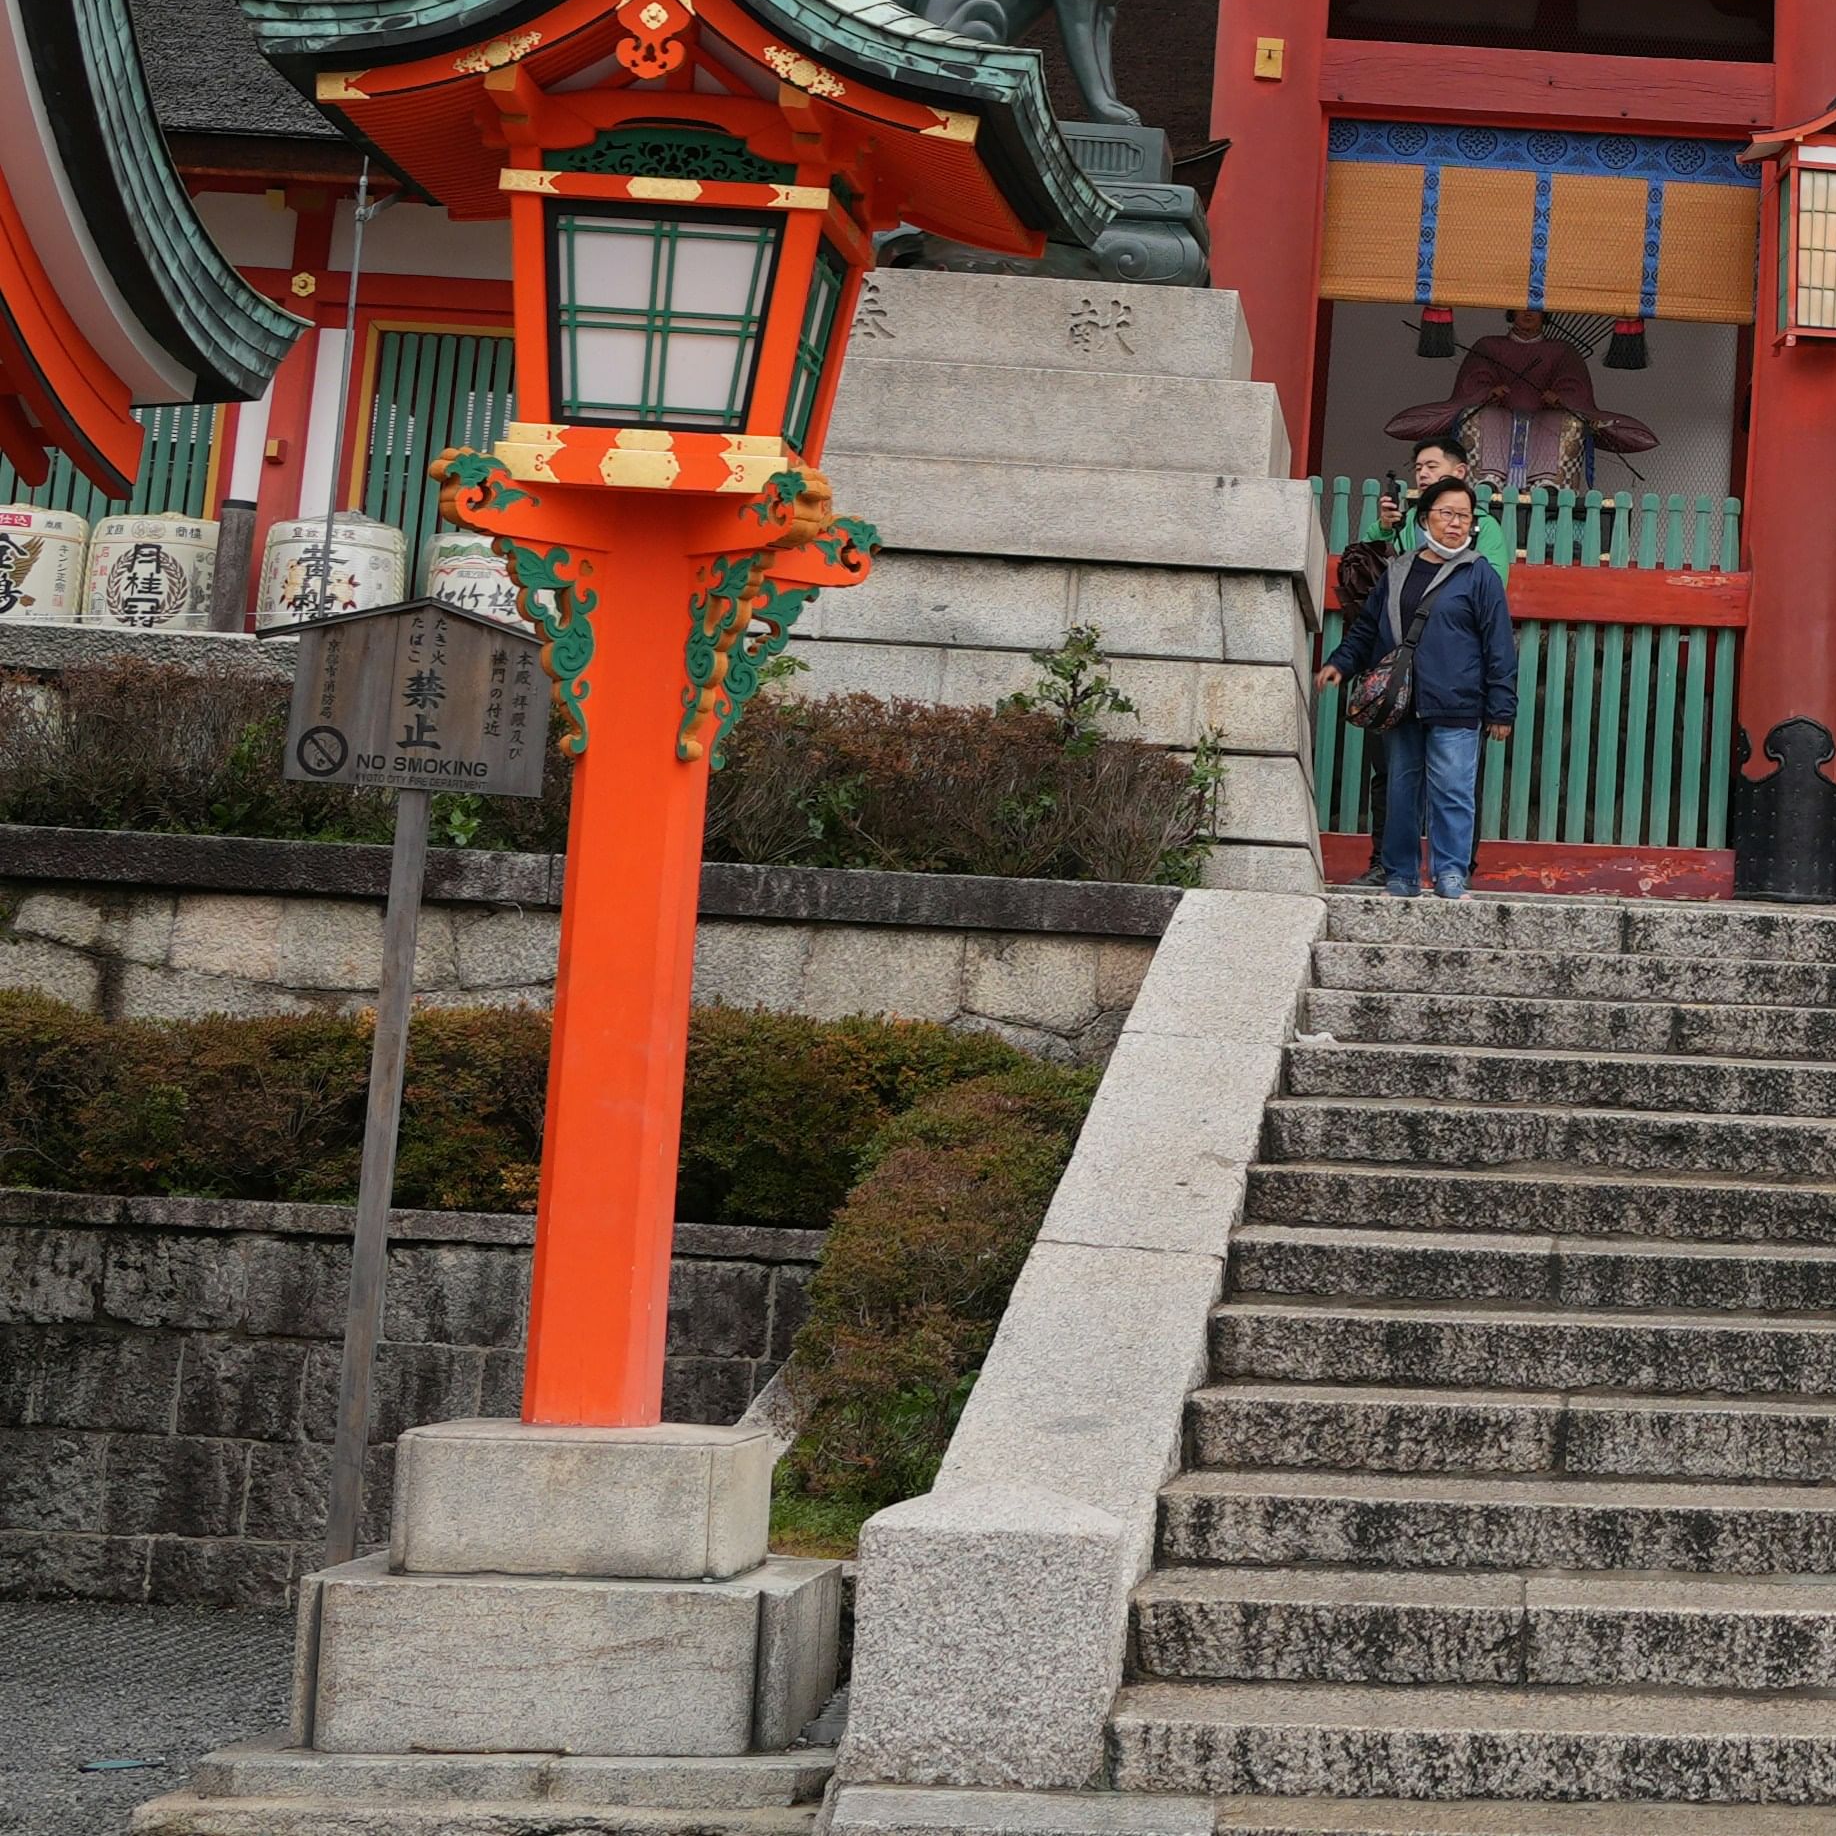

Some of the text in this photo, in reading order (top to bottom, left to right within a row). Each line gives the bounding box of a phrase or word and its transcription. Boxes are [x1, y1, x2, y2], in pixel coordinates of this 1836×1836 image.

[122, 543, 163, 628] 月桂冠
[408, 616, 425, 663] たばこ
[431, 617, 448, 665] たき火
[320, 639, 344, 719] 京都市消防局
[395, 667, 446, 750] 禁止
[355, 772, 385, 783] KYOTO
[387, 774, 406, 784] CITY
[430, 776, 488, 791] DEPARTMENT
[356, 754, 488, 777] NO SMOKING
